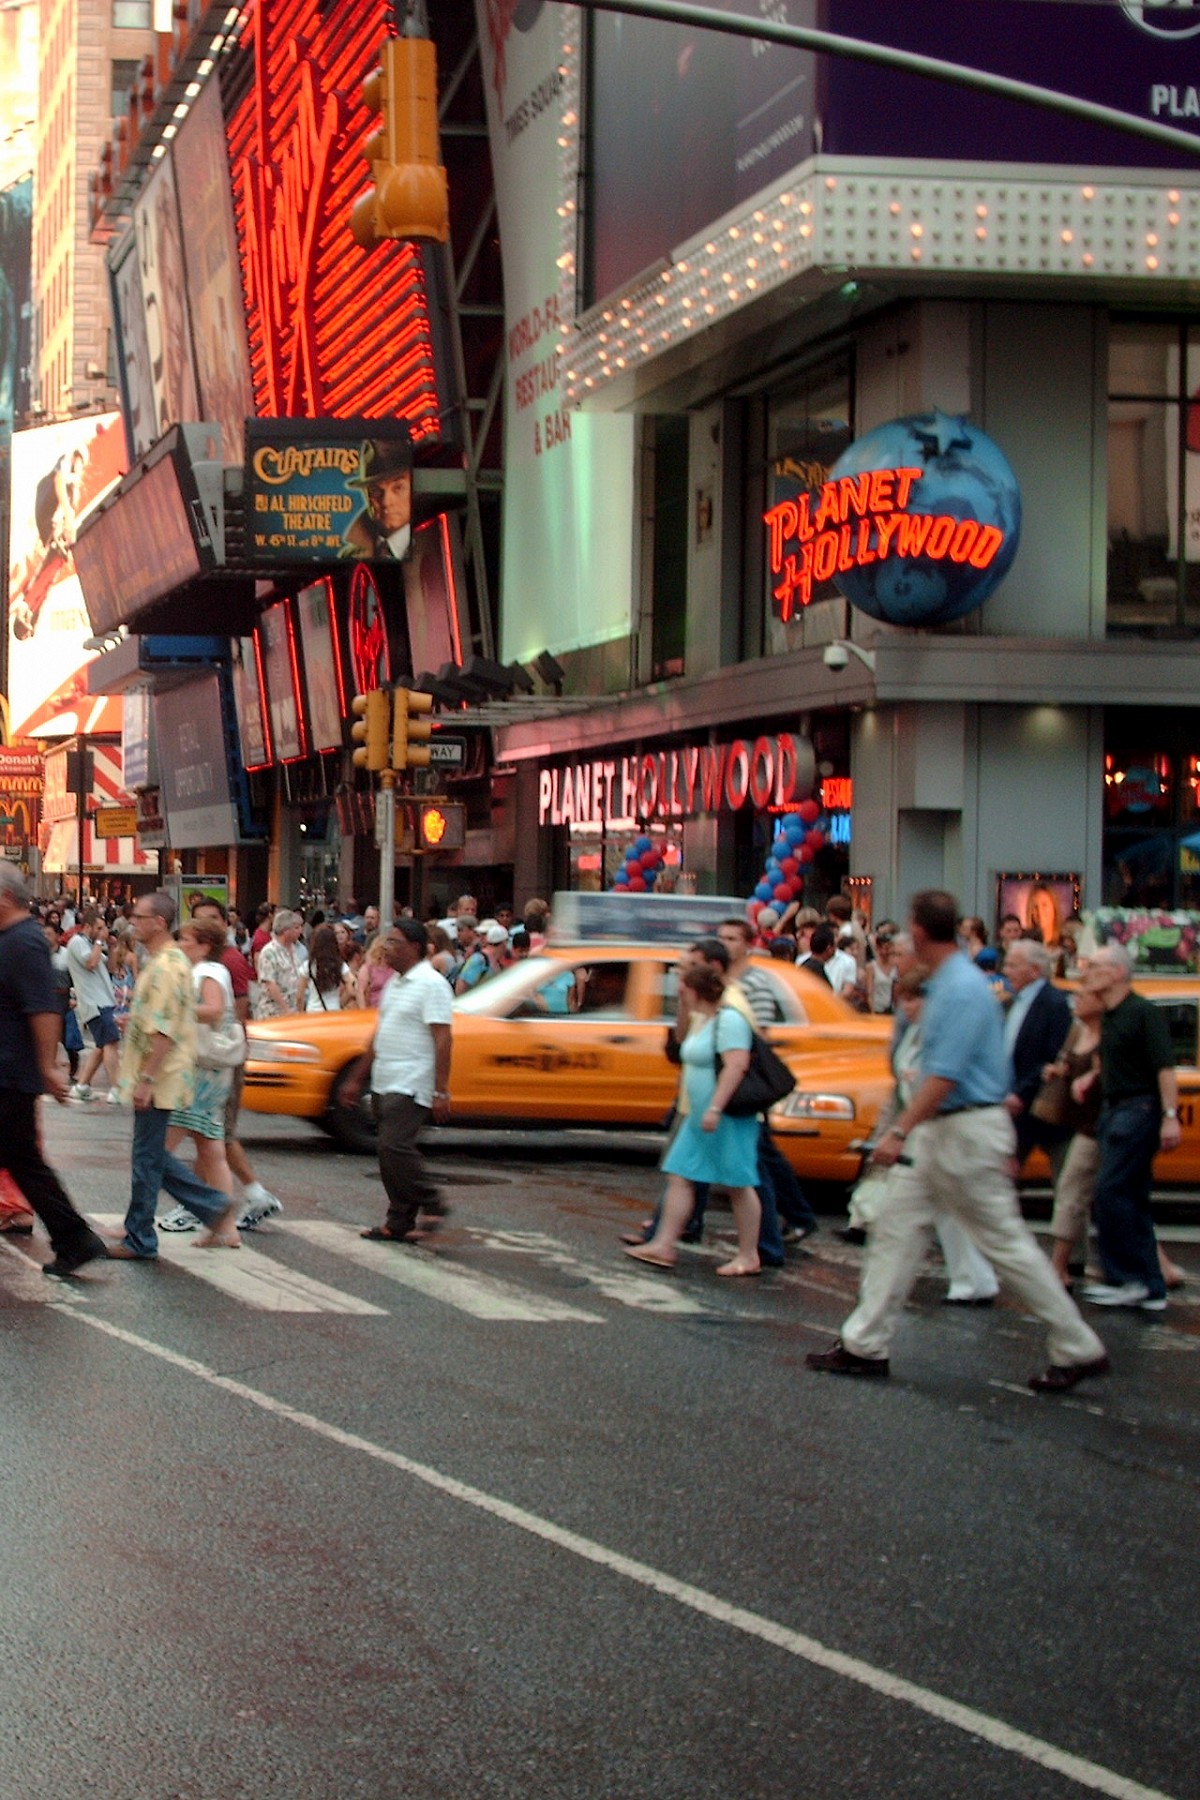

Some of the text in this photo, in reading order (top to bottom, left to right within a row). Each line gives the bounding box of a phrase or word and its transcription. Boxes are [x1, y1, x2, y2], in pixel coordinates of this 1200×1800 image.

[509, 294, 562, 362] WORLD-FA
[516, 352, 561, 412] RESTAU
[545, 410, 571, 449] BAR
[270, 495, 286, 512] AL
[283, 512, 331, 531] THEATRE
[764, 467, 923, 573] PLANET
[774, 513, 1004, 622] HOLLYWOOD
[539, 732, 797, 826] PLANET HOLLYWOOD
